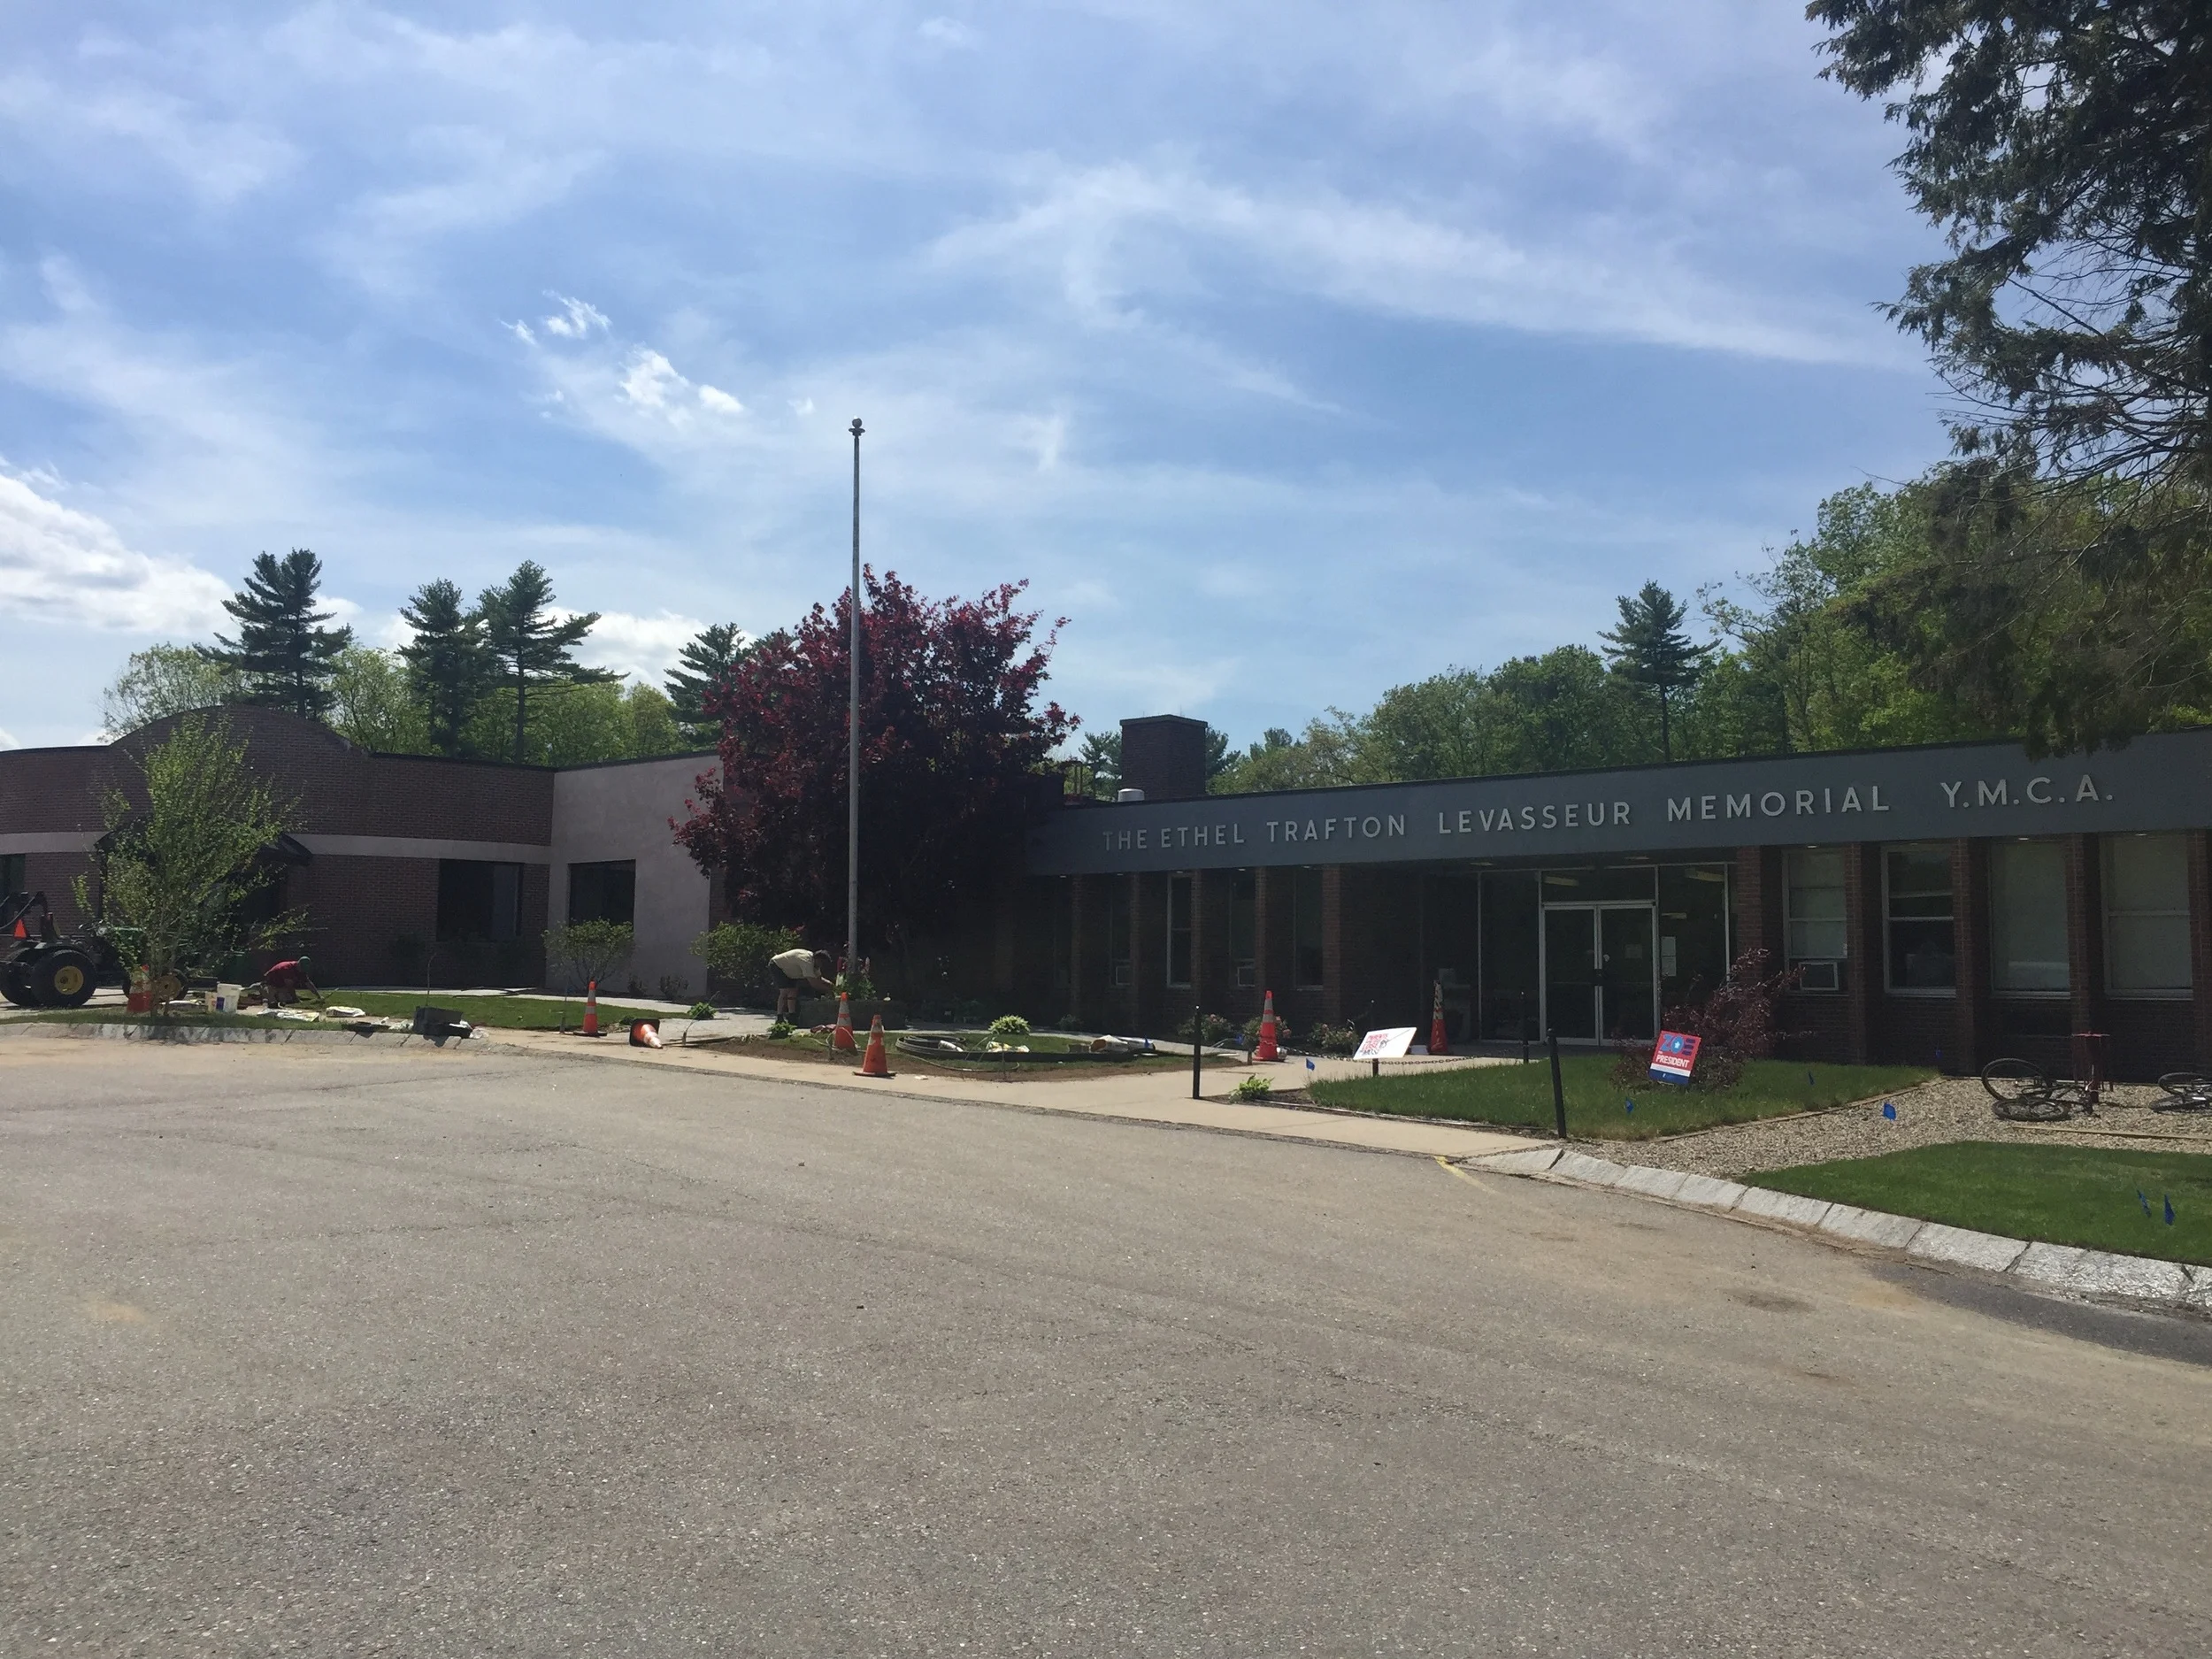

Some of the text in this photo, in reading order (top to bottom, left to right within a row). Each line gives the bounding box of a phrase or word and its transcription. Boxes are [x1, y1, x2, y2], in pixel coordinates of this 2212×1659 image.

[1102, 774, 2114, 850] THE ETHEL TRAFTON LEVASSEUR MEMORIAL Y.M.C.A.
[1655, 1055, 1690, 1069] PRESIDENT
